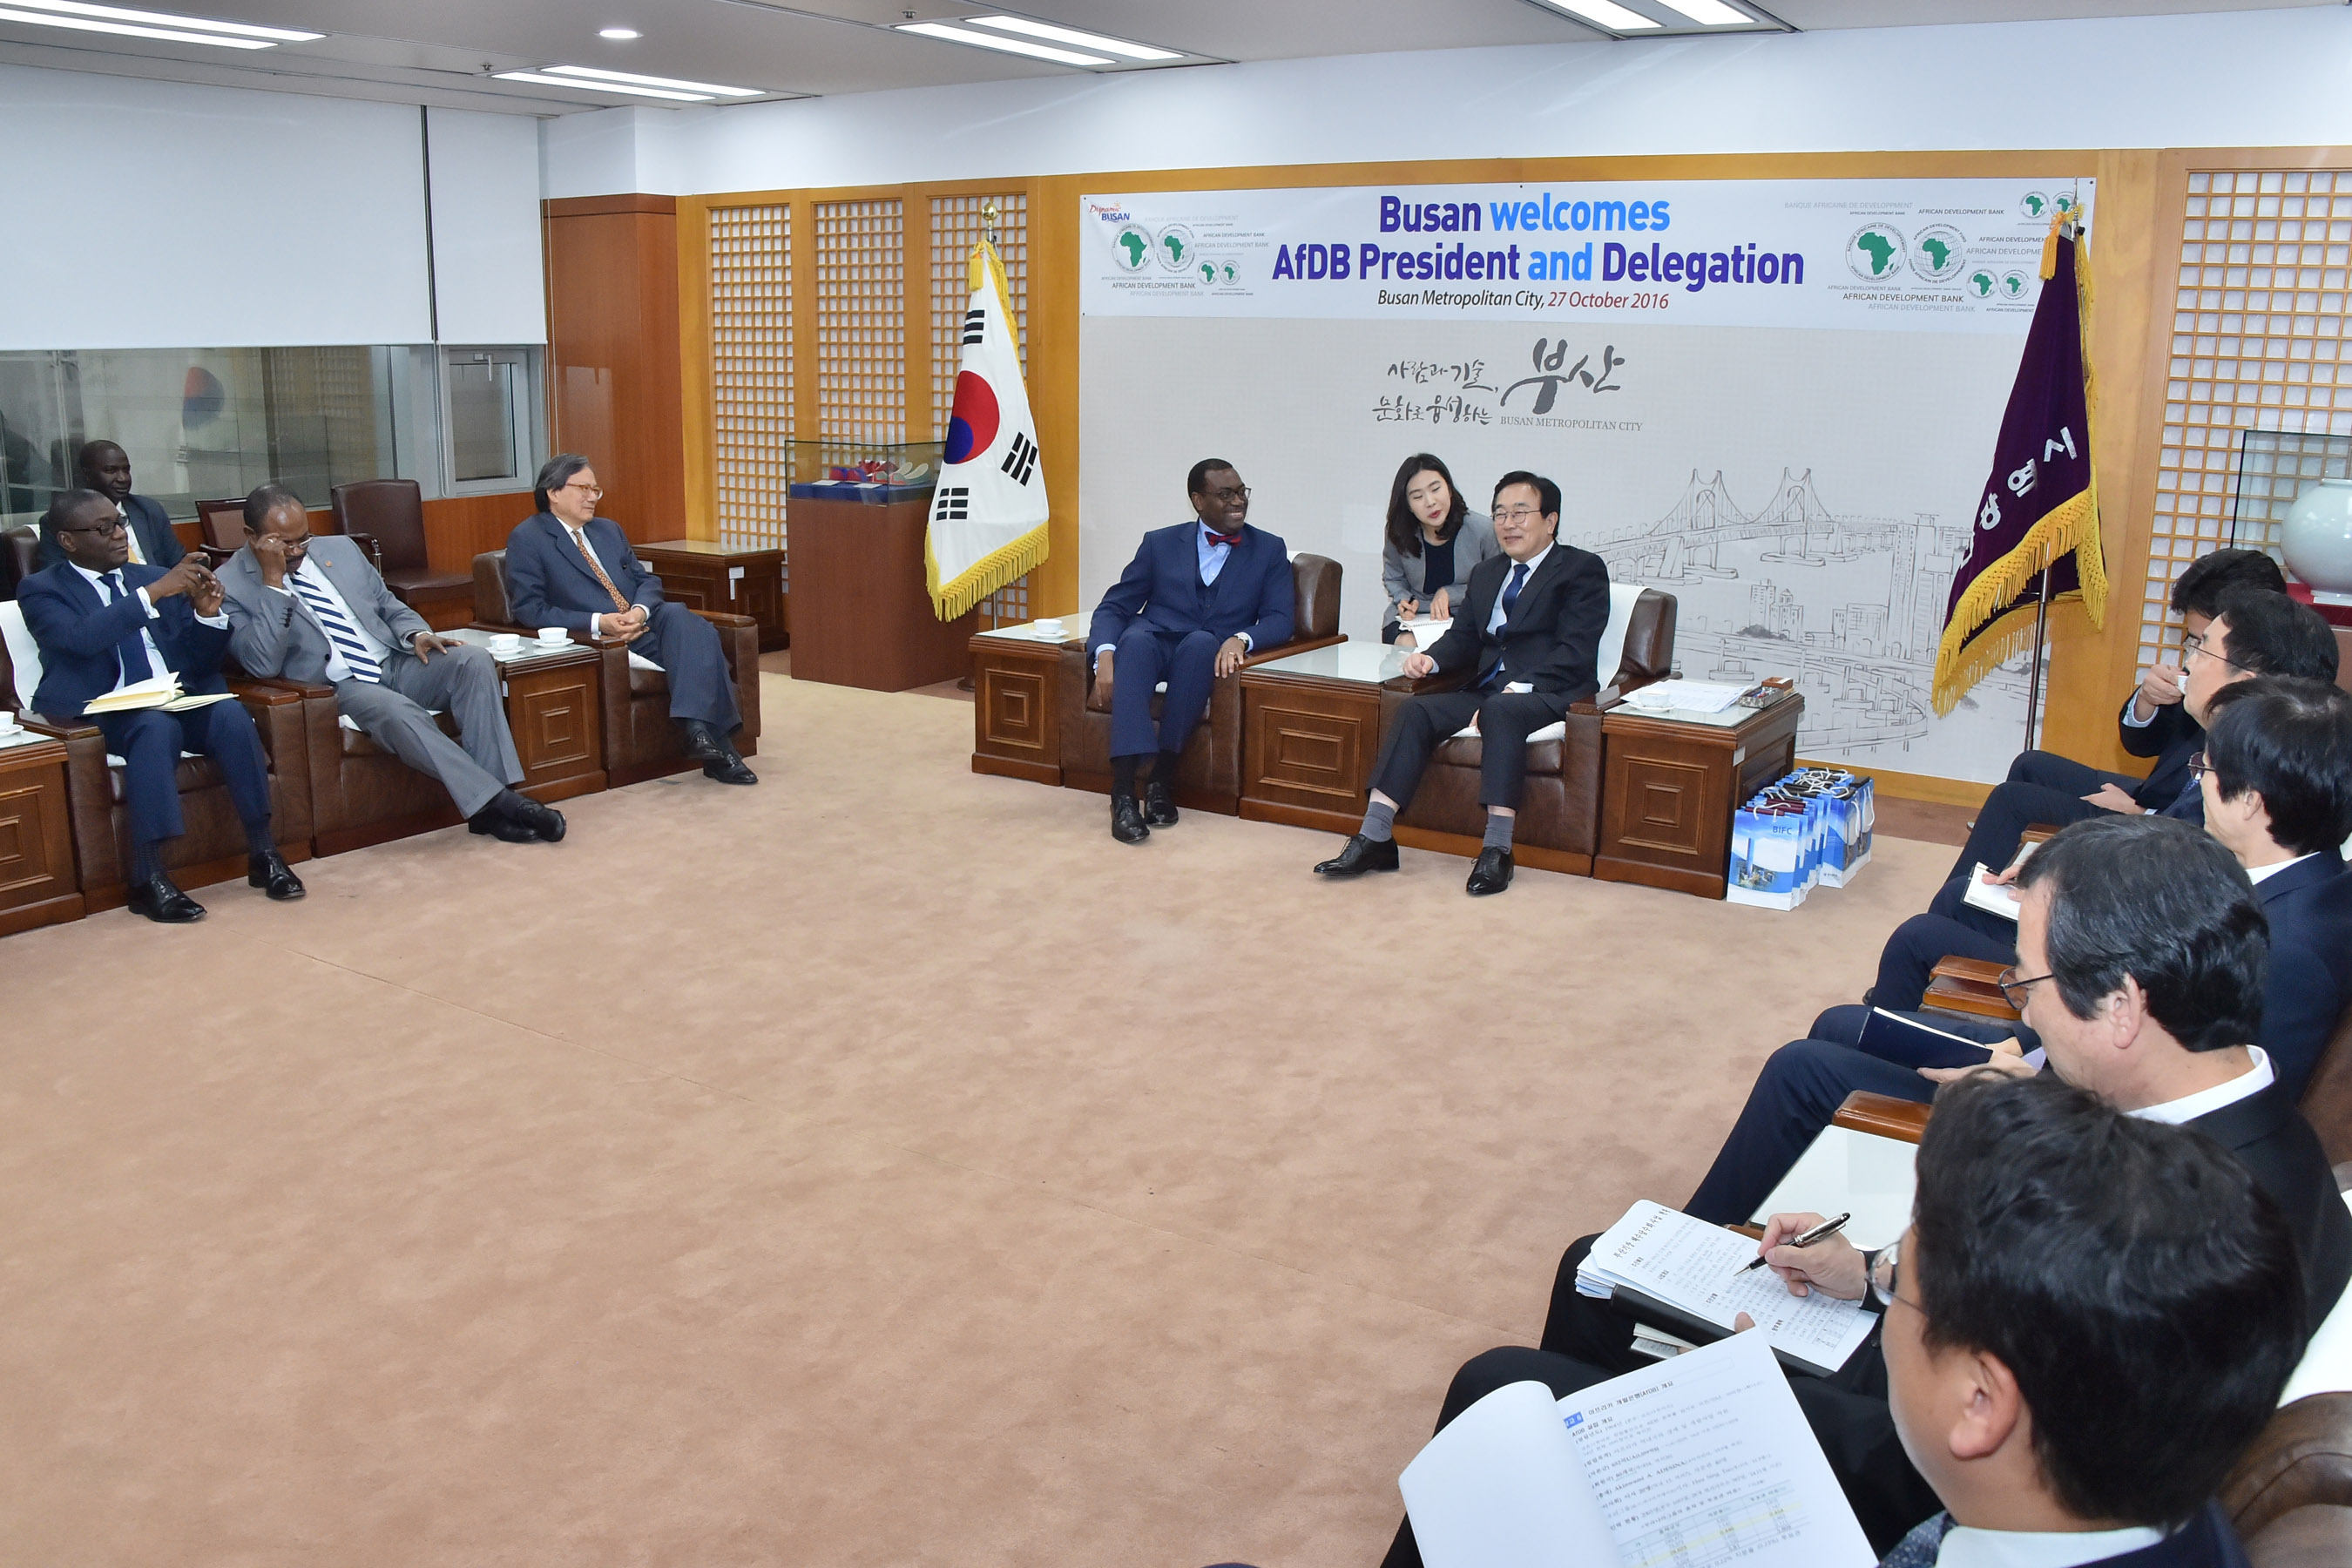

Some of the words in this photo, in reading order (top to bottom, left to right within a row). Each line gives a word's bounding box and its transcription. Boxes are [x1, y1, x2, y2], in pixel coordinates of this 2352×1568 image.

[1380, 196, 1481, 232] Busan
[1490, 193, 1670, 231] welcomes
[1913, 226, 1929, 240] AFRICAN
[1930, 223, 1960, 233] DEVELOPMENT
[1272, 243, 1350, 280] AfDB
[1360, 242, 1520, 280] President
[1528, 242, 1592, 280] and
[1603, 242, 1804, 292] Delegation
[1378, 290, 1418, 305] Busan
[1422, 290, 1511, 309] Metropolitan
[1516, 291, 1545, 310] City,
[1548, 292, 1566, 306] 27
[1570, 292, 1629, 308] October
[1631, 294, 1669, 308] 2016
[1842, 293, 1877, 302] AFRICAN
[1878, 294, 1939, 303] DEVELOPMENT
[1941, 294, 1963, 303] BANK
[1869, 302, 1898, 311] AFRICAN
[1900, 303, 1953, 312] DEVELOPMENT
[1500, 338, 1625, 415] 부산
[1500, 416, 1533, 426] BUSAN
[1536, 418, 1617, 430] METROPOLITAN
[1619, 422, 1643, 431] CITY
[1772, 825, 1793, 835] BIFC
[1588, 1402, 1613, 1416] 아프리카
